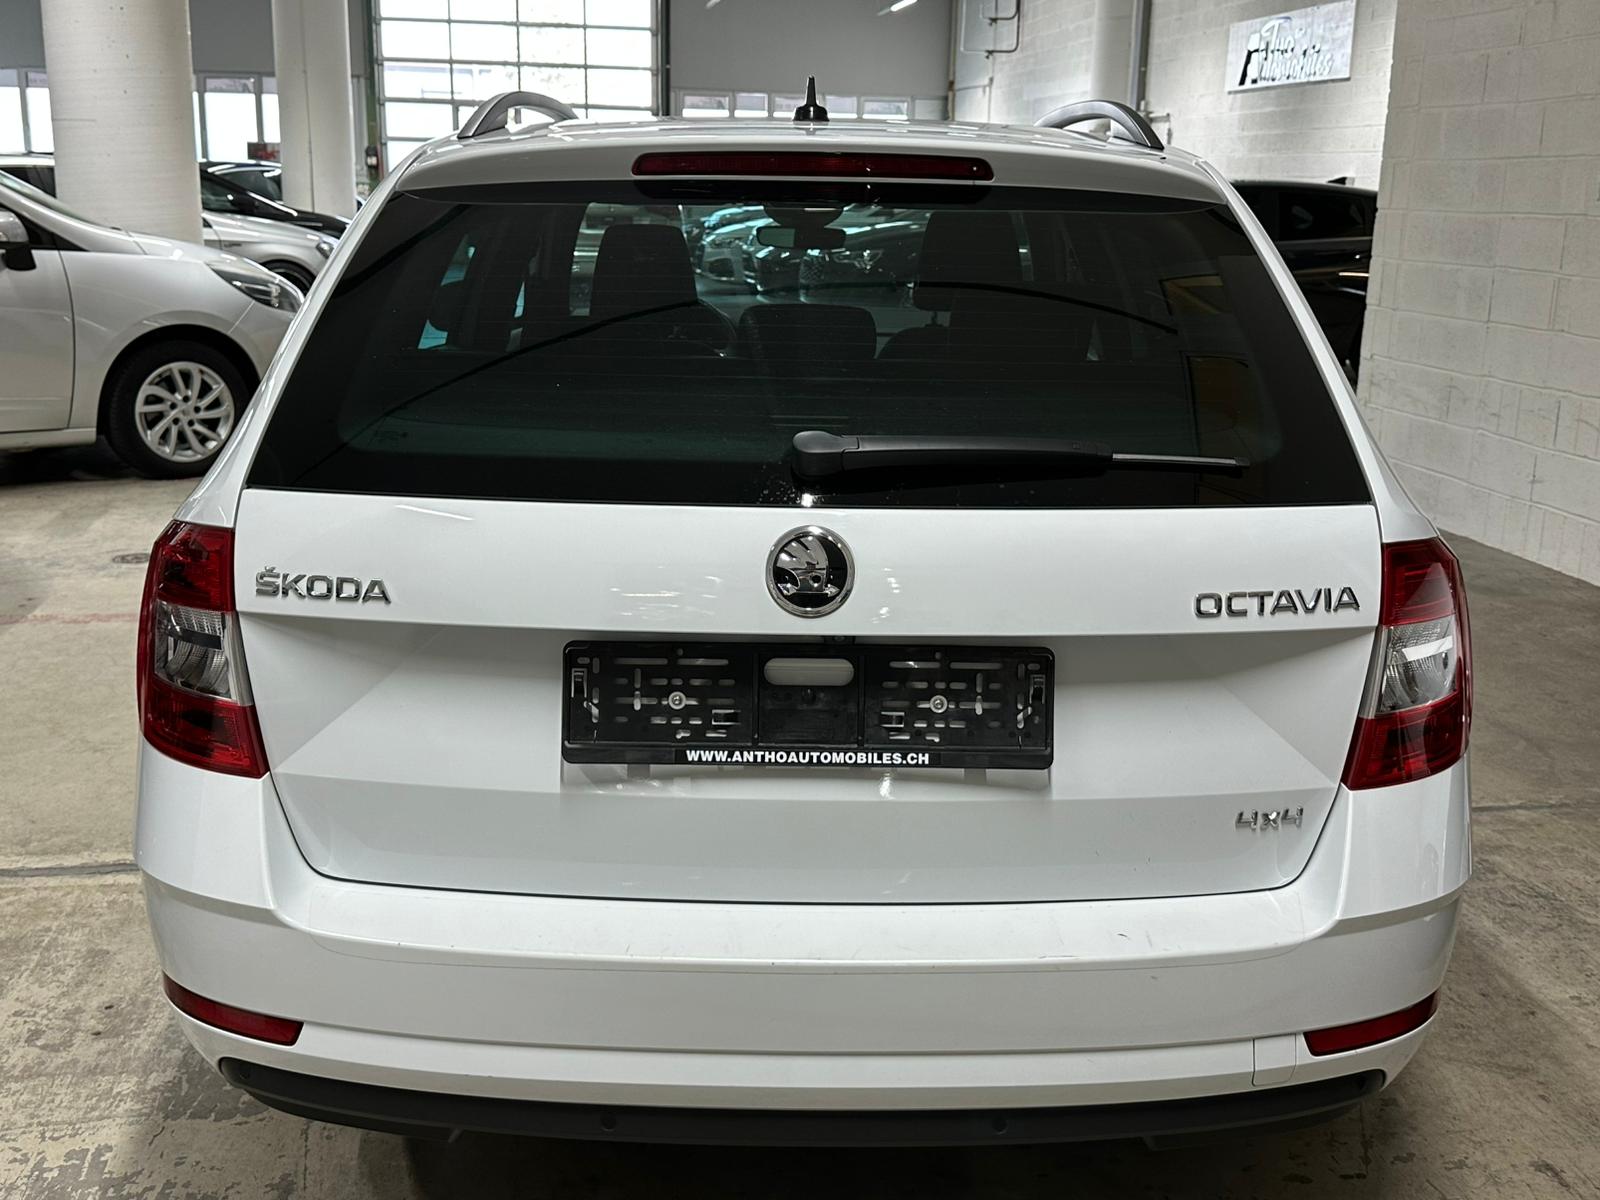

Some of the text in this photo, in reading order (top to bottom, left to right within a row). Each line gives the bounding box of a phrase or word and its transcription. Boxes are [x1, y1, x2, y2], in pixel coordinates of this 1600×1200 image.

[256, 566, 391, 604] ŠKODA
[1194, 586, 1360, 618] OCTAVIA
[686, 750, 929, 764] WWW.ANTHOAUTOMOBILES.CH
